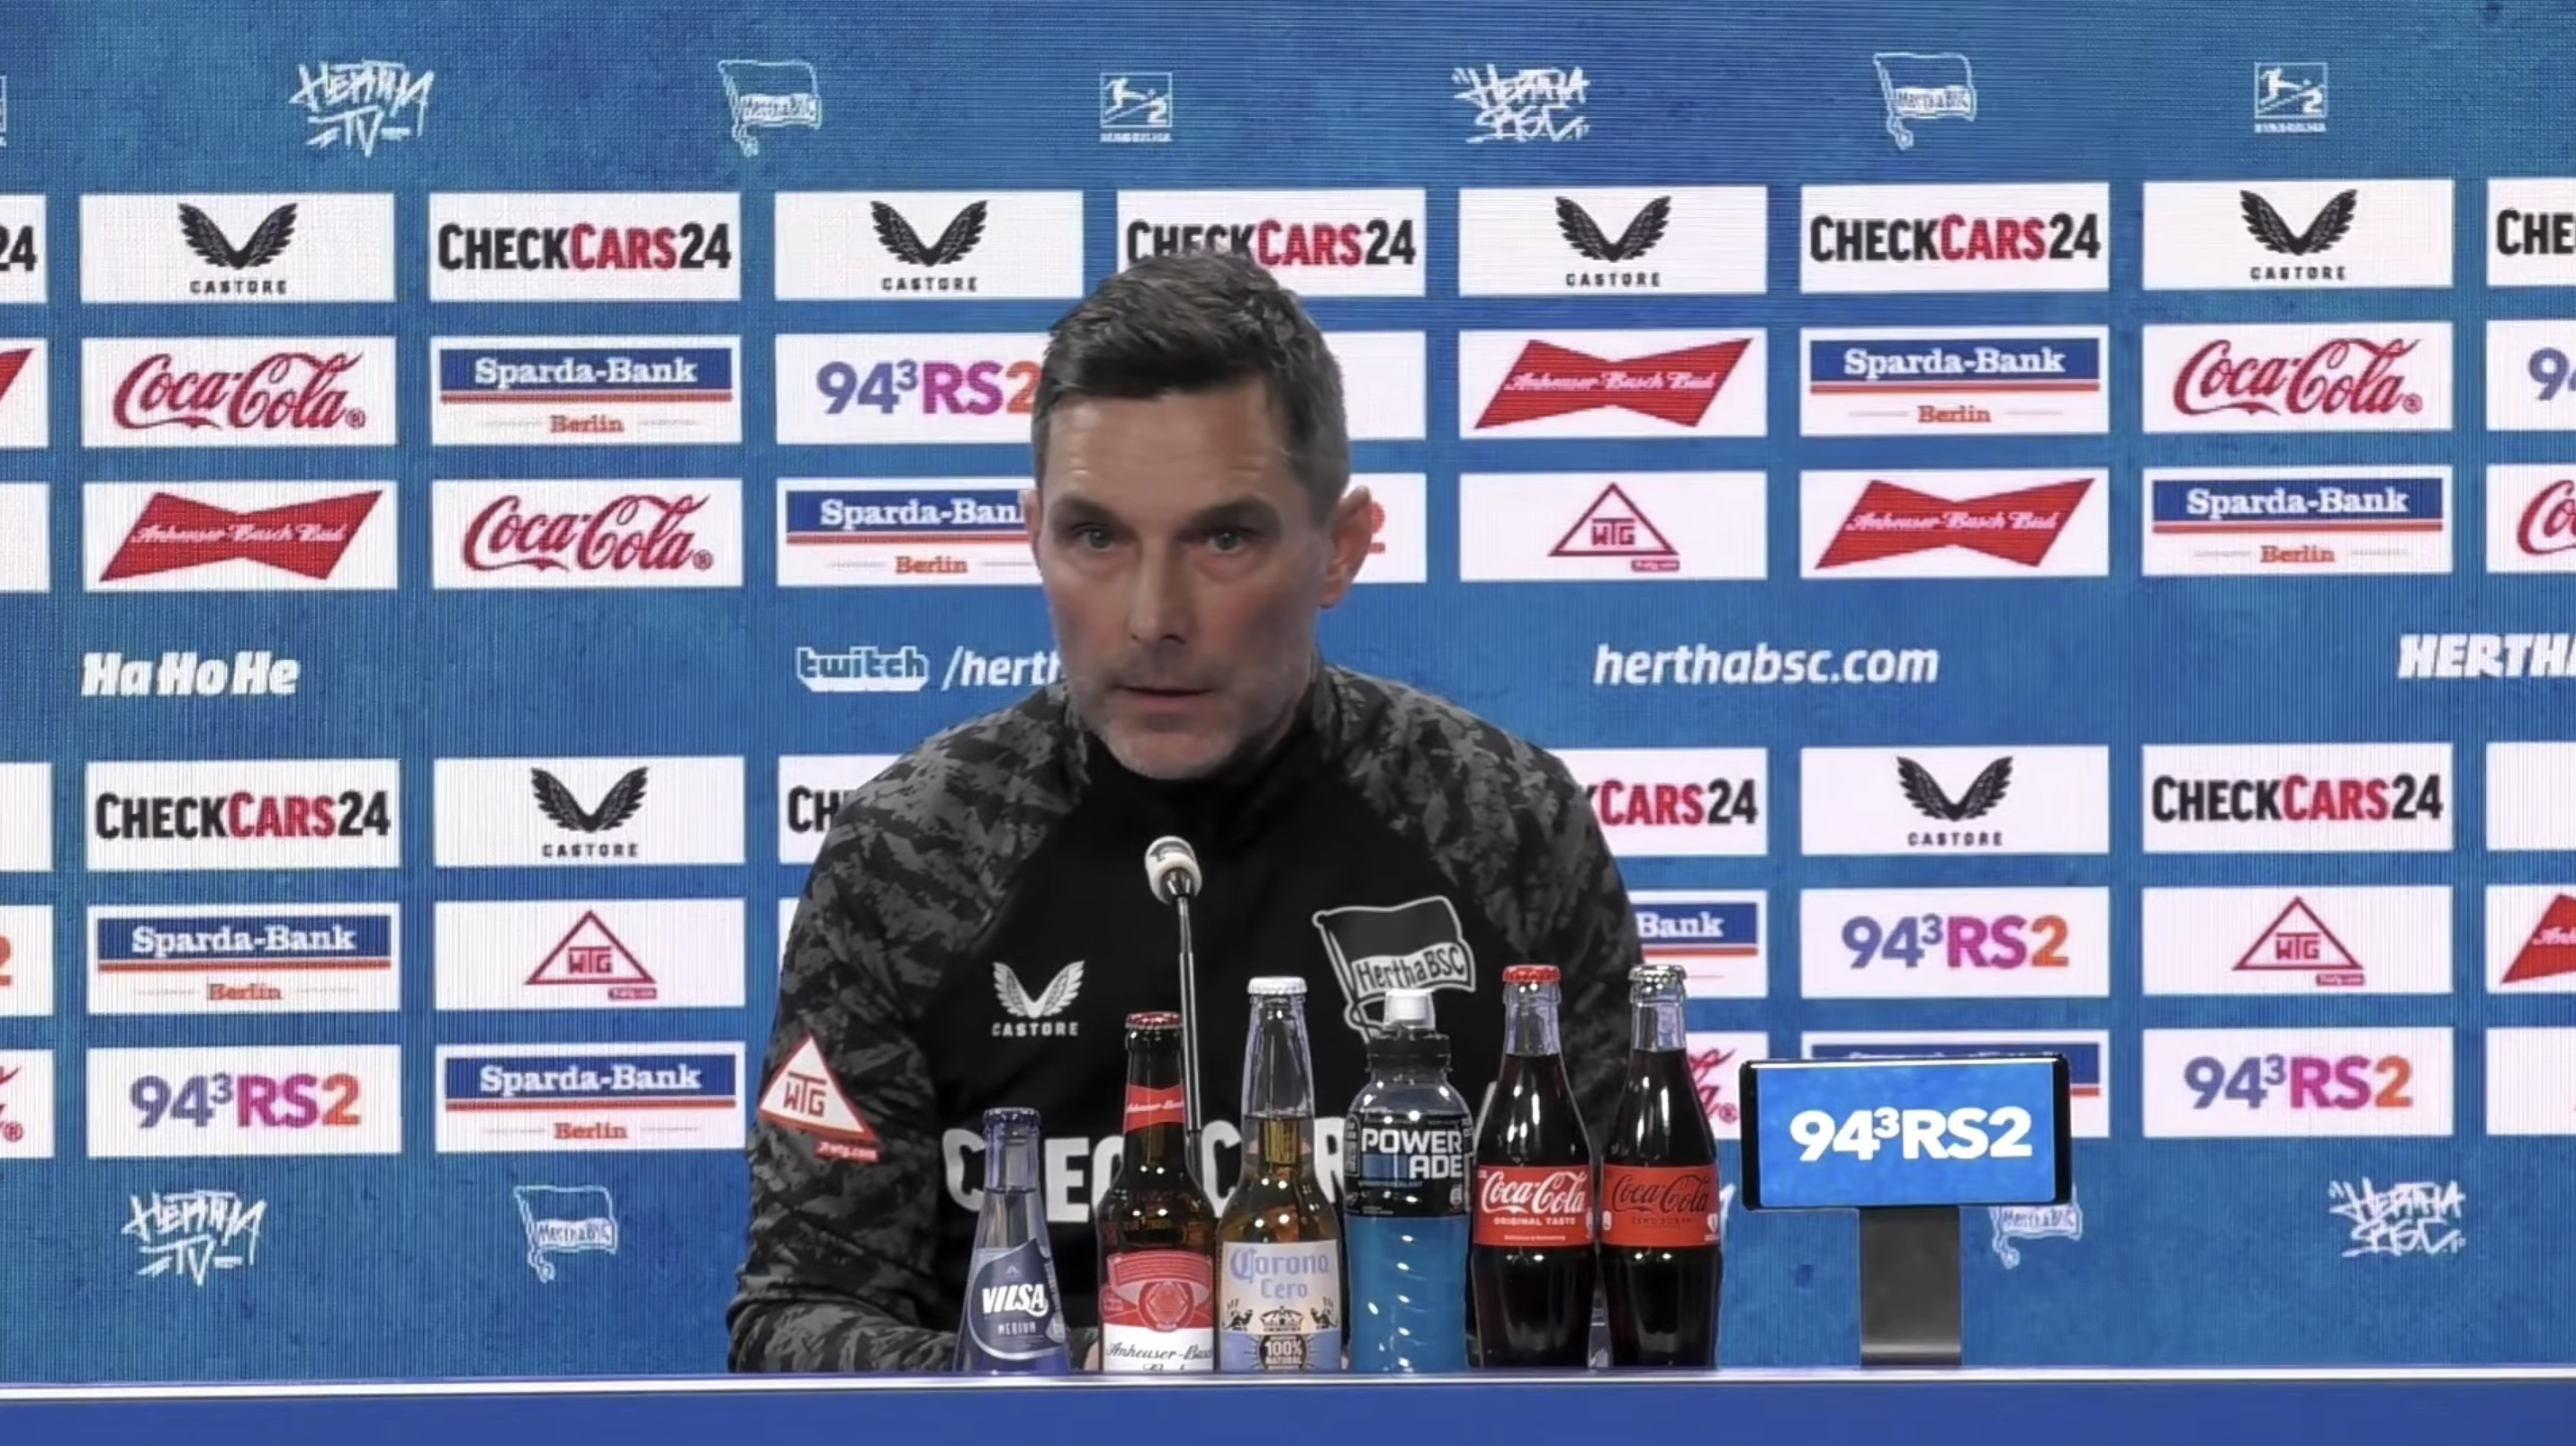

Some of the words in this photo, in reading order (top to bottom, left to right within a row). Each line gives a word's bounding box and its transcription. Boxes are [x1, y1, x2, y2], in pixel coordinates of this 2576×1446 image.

[437, 221, 732, 272] CHECKCARS24
[1809, 212, 2102, 263] CHECKCARS24
[190, 279, 286, 295] CASTORE
[882, 276, 977, 292] CASTORE
[1565, 272, 1660, 287] CASTORE
[2250, 266, 2345, 281] CASTORE
[475, 357, 698, 386] Sparda-Bank
[1844, 348, 2066, 379] Sparda-Bank
[551, 415, 624, 433] Berlin
[1918, 405, 1991, 423] Berlin
[2187, 488, 2409, 518] Sparda-Bank
[1591, 518, 1635, 546] WTG
[896, 556, 968, 574] Berlin
[2261, 545, 2335, 563] Berlin
[797, 646, 930, 692] twitch
[1595, 644, 1938, 684] herthabsc.com
[1591, 778, 1758, 827] CARS24
[2151, 773, 2444, 823] CHECKCARS24
[95, 790, 392, 841] CHECKCARS24
[542, 843, 637, 858] CASTORE
[1907, 832, 2002, 846] CASTORE
[131, 926, 356, 957] Sparda-Bank
[2275, 933, 2320, 960] WTG
[568, 946, 613, 973] WTG
[209, 983, 282, 1000] Berlin
[992, 1022, 1077, 1037] CASTORE
[480, 1065, 701, 1096] Sparda-Bank
[783, 1071, 827, 1116] WTG
[554, 1122, 627, 1140] Berlin
[1361, 1128, 1462, 1154] POWER
[1409, 1155, 1463, 1179] ADE
[1481, 1170, 1588, 1215] Coca-Cola
[1610, 1174, 1709, 1214] Coca-Cola
[1493, 1216, 1543, 1226] ORIGINAL
[1546, 1216, 1576, 1225] TASTE
[1230, 1247, 1329, 1282] Corona
[982, 1283, 1049, 1317] VILSA
[1261, 1278, 1308, 1299] Cero
[997, 1321, 1036, 1335] MEDIUM
[1265, 1340, 1303, 1357] 100%
